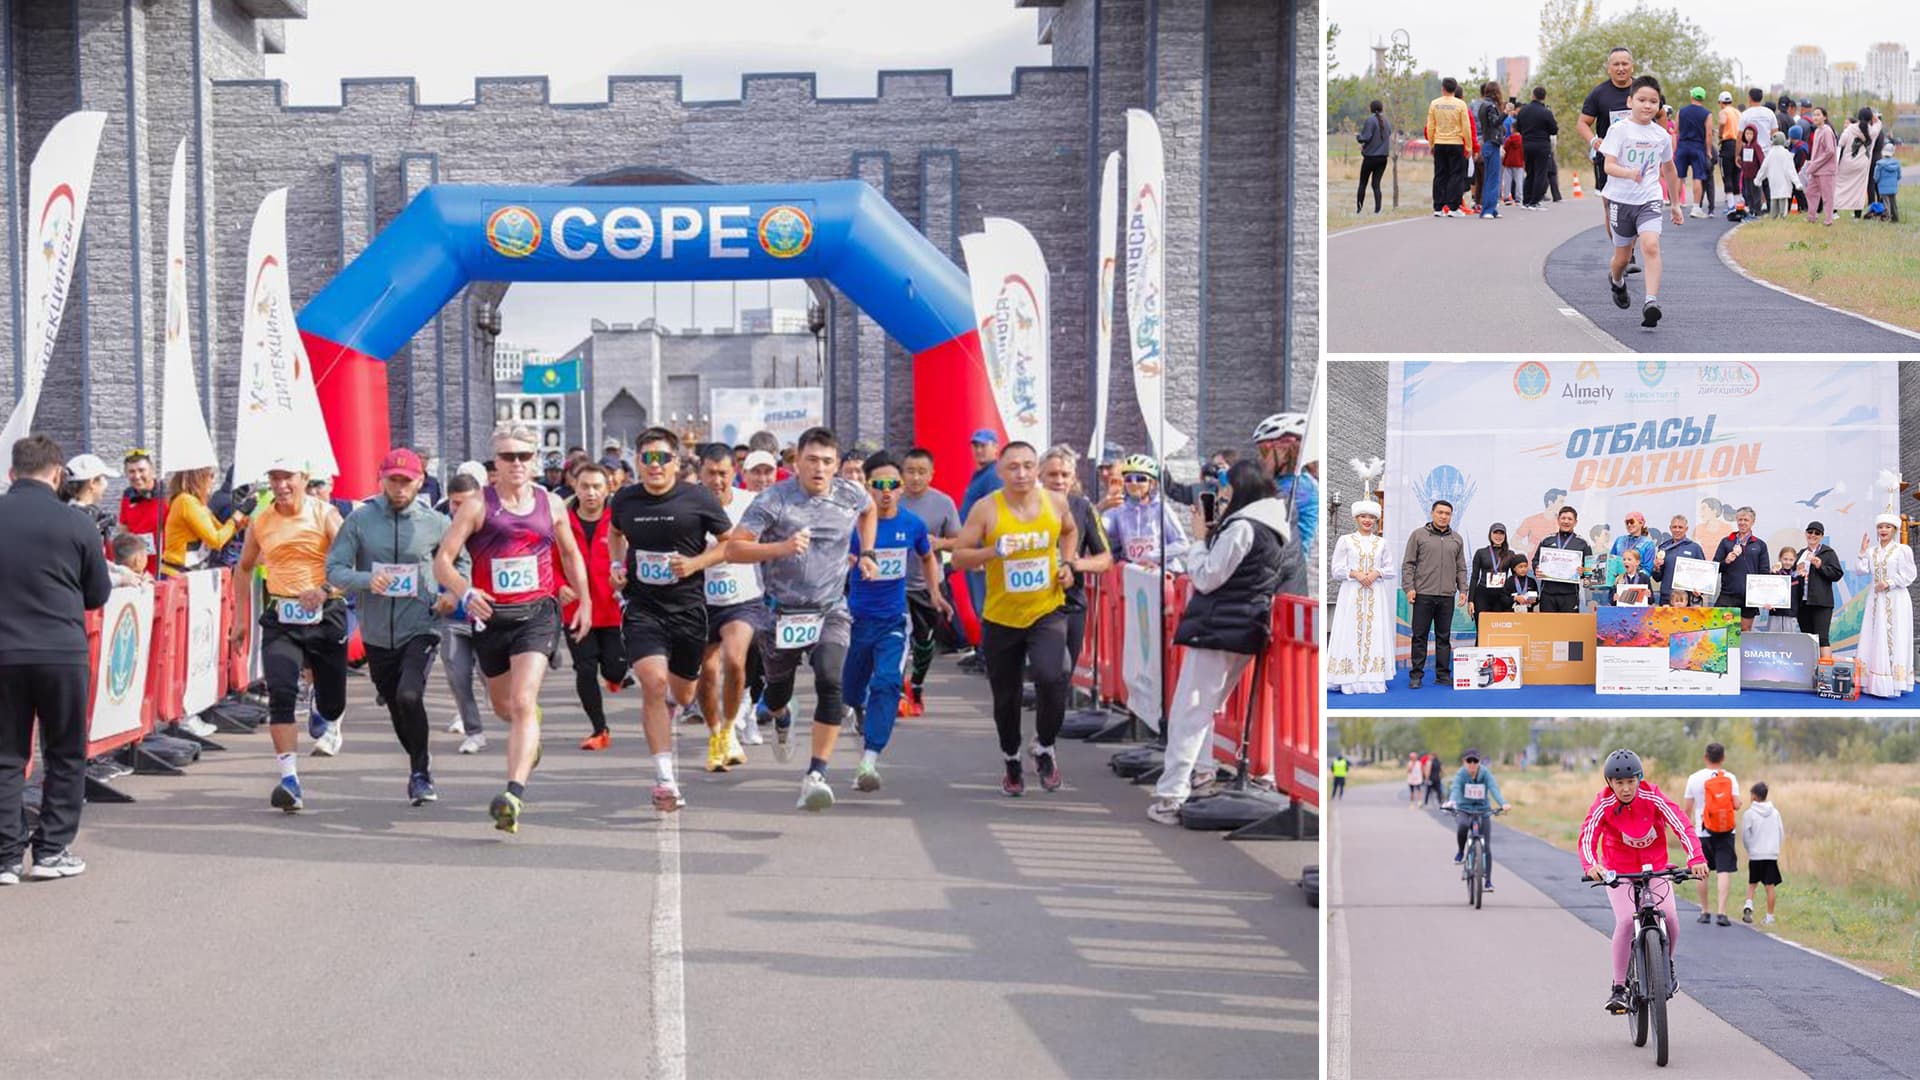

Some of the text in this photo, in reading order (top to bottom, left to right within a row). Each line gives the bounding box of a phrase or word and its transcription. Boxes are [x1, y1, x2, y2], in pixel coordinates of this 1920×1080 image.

[1627, 149, 1656, 165] 014
[551, 206, 750, 260] СӨРЕ
[1561, 383, 1614, 400] Almaty
[1565, 414, 1717, 459] ОТБАСЫ
[1570, 442, 1763, 492] DUATHLON
[880, 560, 902, 575] 22
[389, 575, 411, 592] 24
[498, 569, 535, 588] 025
[706, 579, 737, 595] 008
[1010, 569, 1045, 588] 004
[783, 626, 817, 643] 020
[1744, 650, 1793, 659] SMART TV
